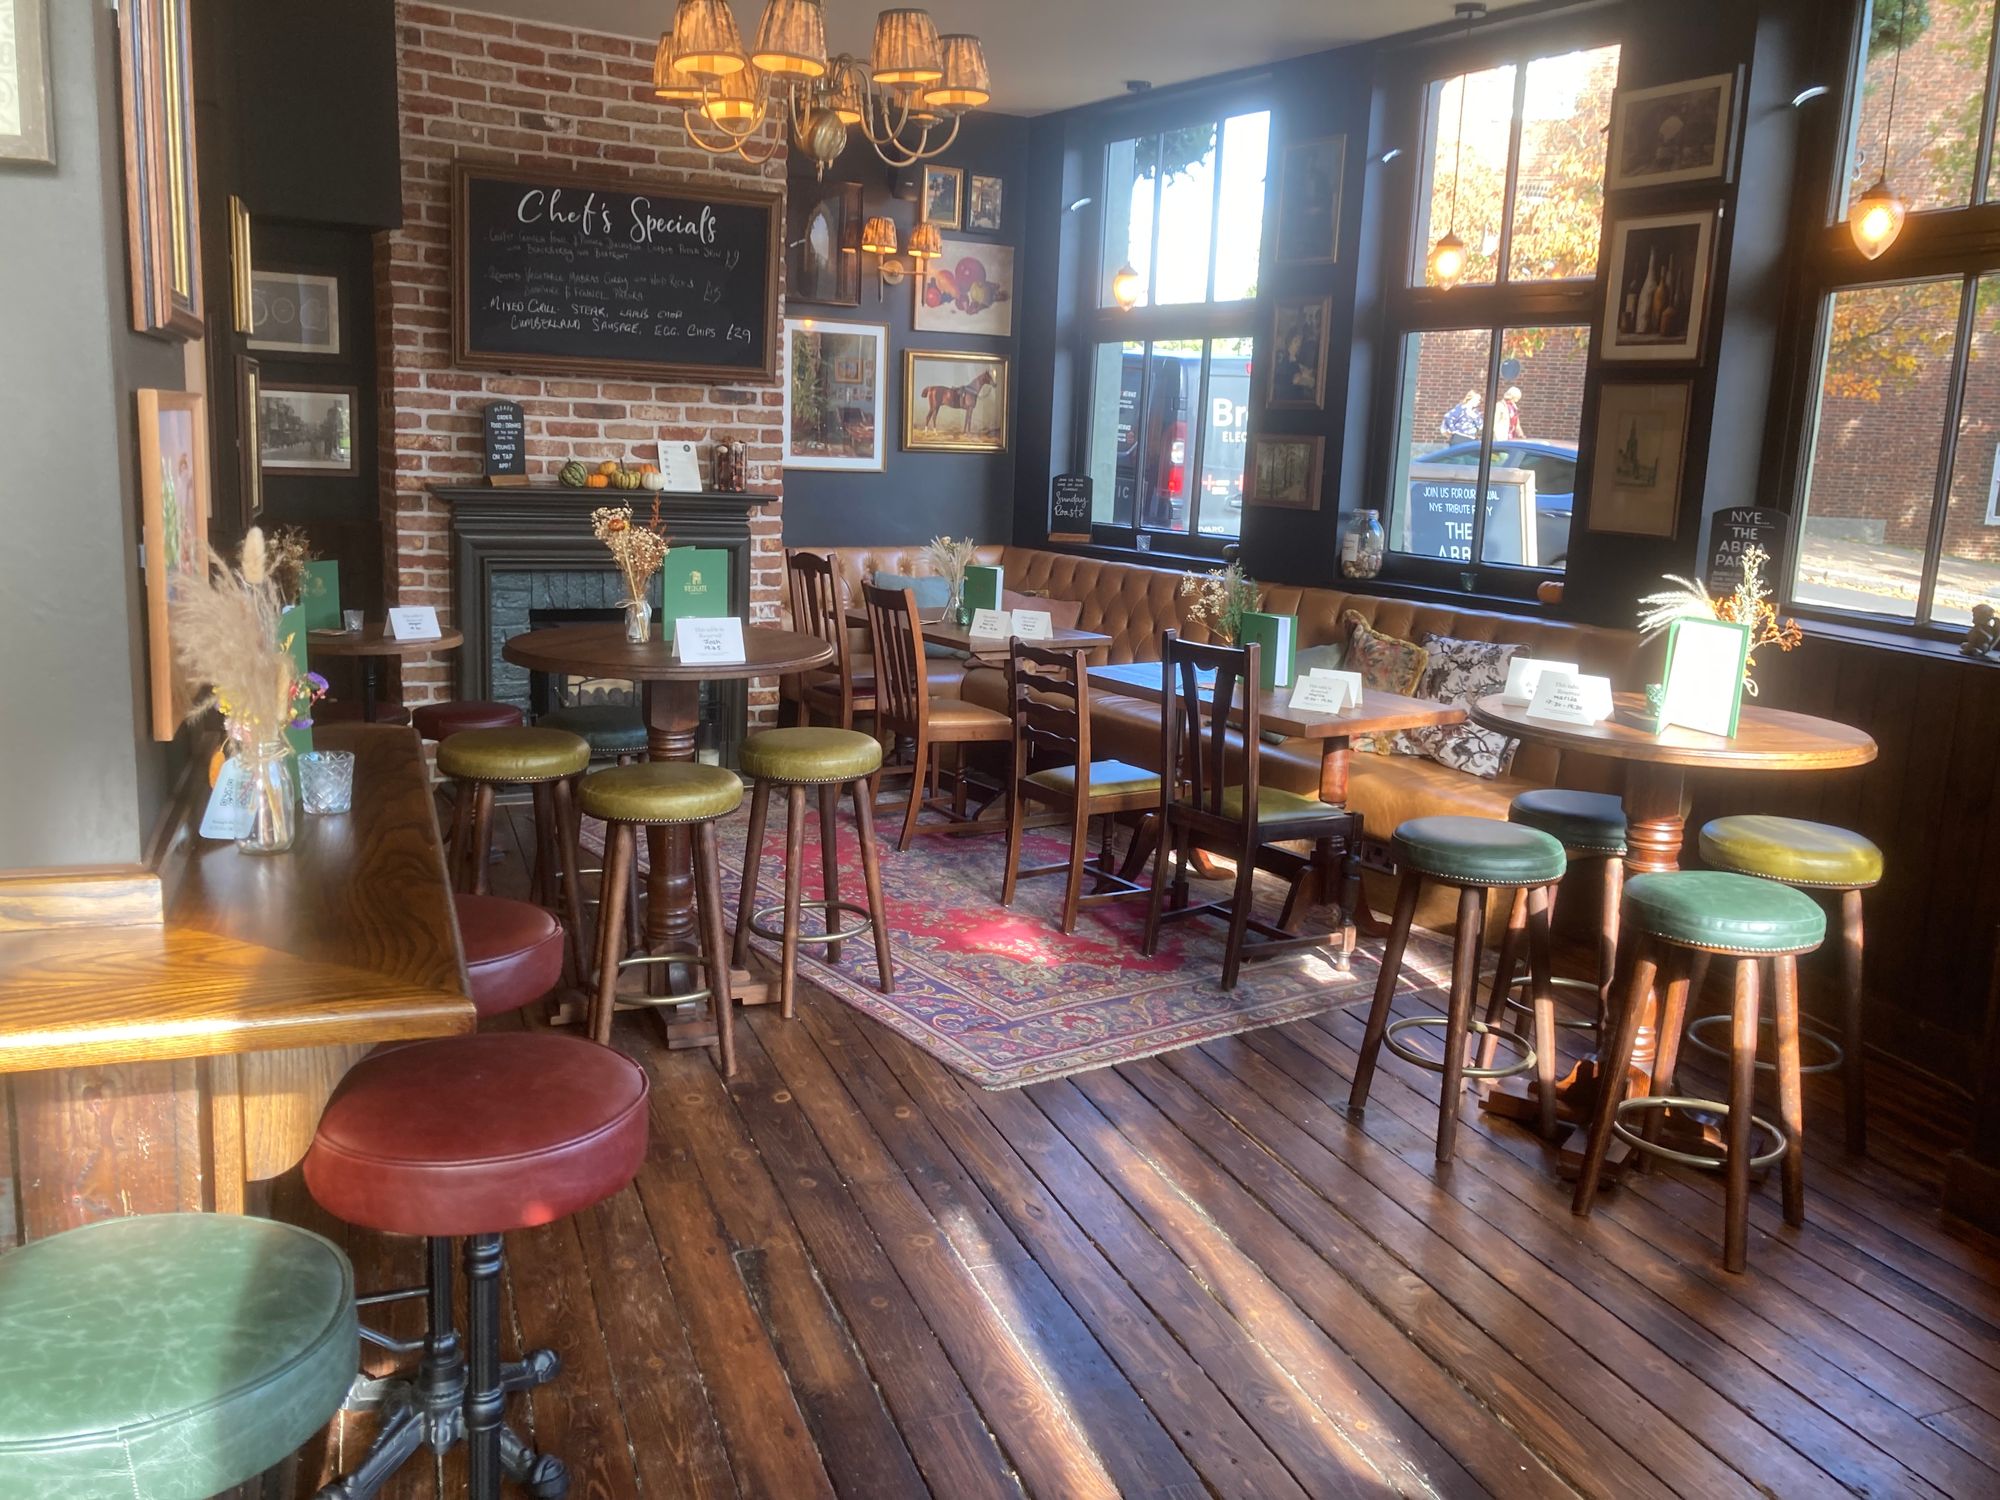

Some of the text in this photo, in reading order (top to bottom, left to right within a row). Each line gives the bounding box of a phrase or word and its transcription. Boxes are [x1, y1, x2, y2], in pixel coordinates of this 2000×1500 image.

[518, 189, 717, 244] Chef's Specials
[490, 295, 524, 312] MIXED
[510, 315, 581, 330] CUMBERLAND
[686, 323, 716, 338] CHIPS
[726, 323, 751, 344] £29
[1212, 397, 1248, 428] Br
[1055, 491, 1088, 509] Sunday
[1423, 486, 1439, 498] JOIN
[1440, 487, 1450, 498] US
[1451, 488, 1464, 499] FOR
[1464, 488, 1476, 500] OUR
[1054, 504, 1084, 518] Roasts
[1428, 502, 1443, 512] NYE
[1445, 503, 1471, 514] TRIBUTE
[1731, 510, 1770, 525] NYE
[1197, 526, 1225, 535] IVARO
[1444, 521, 1473, 540] THE
[1732, 527, 1758, 540] THE
[1438, 544, 1472, 560] ABB
